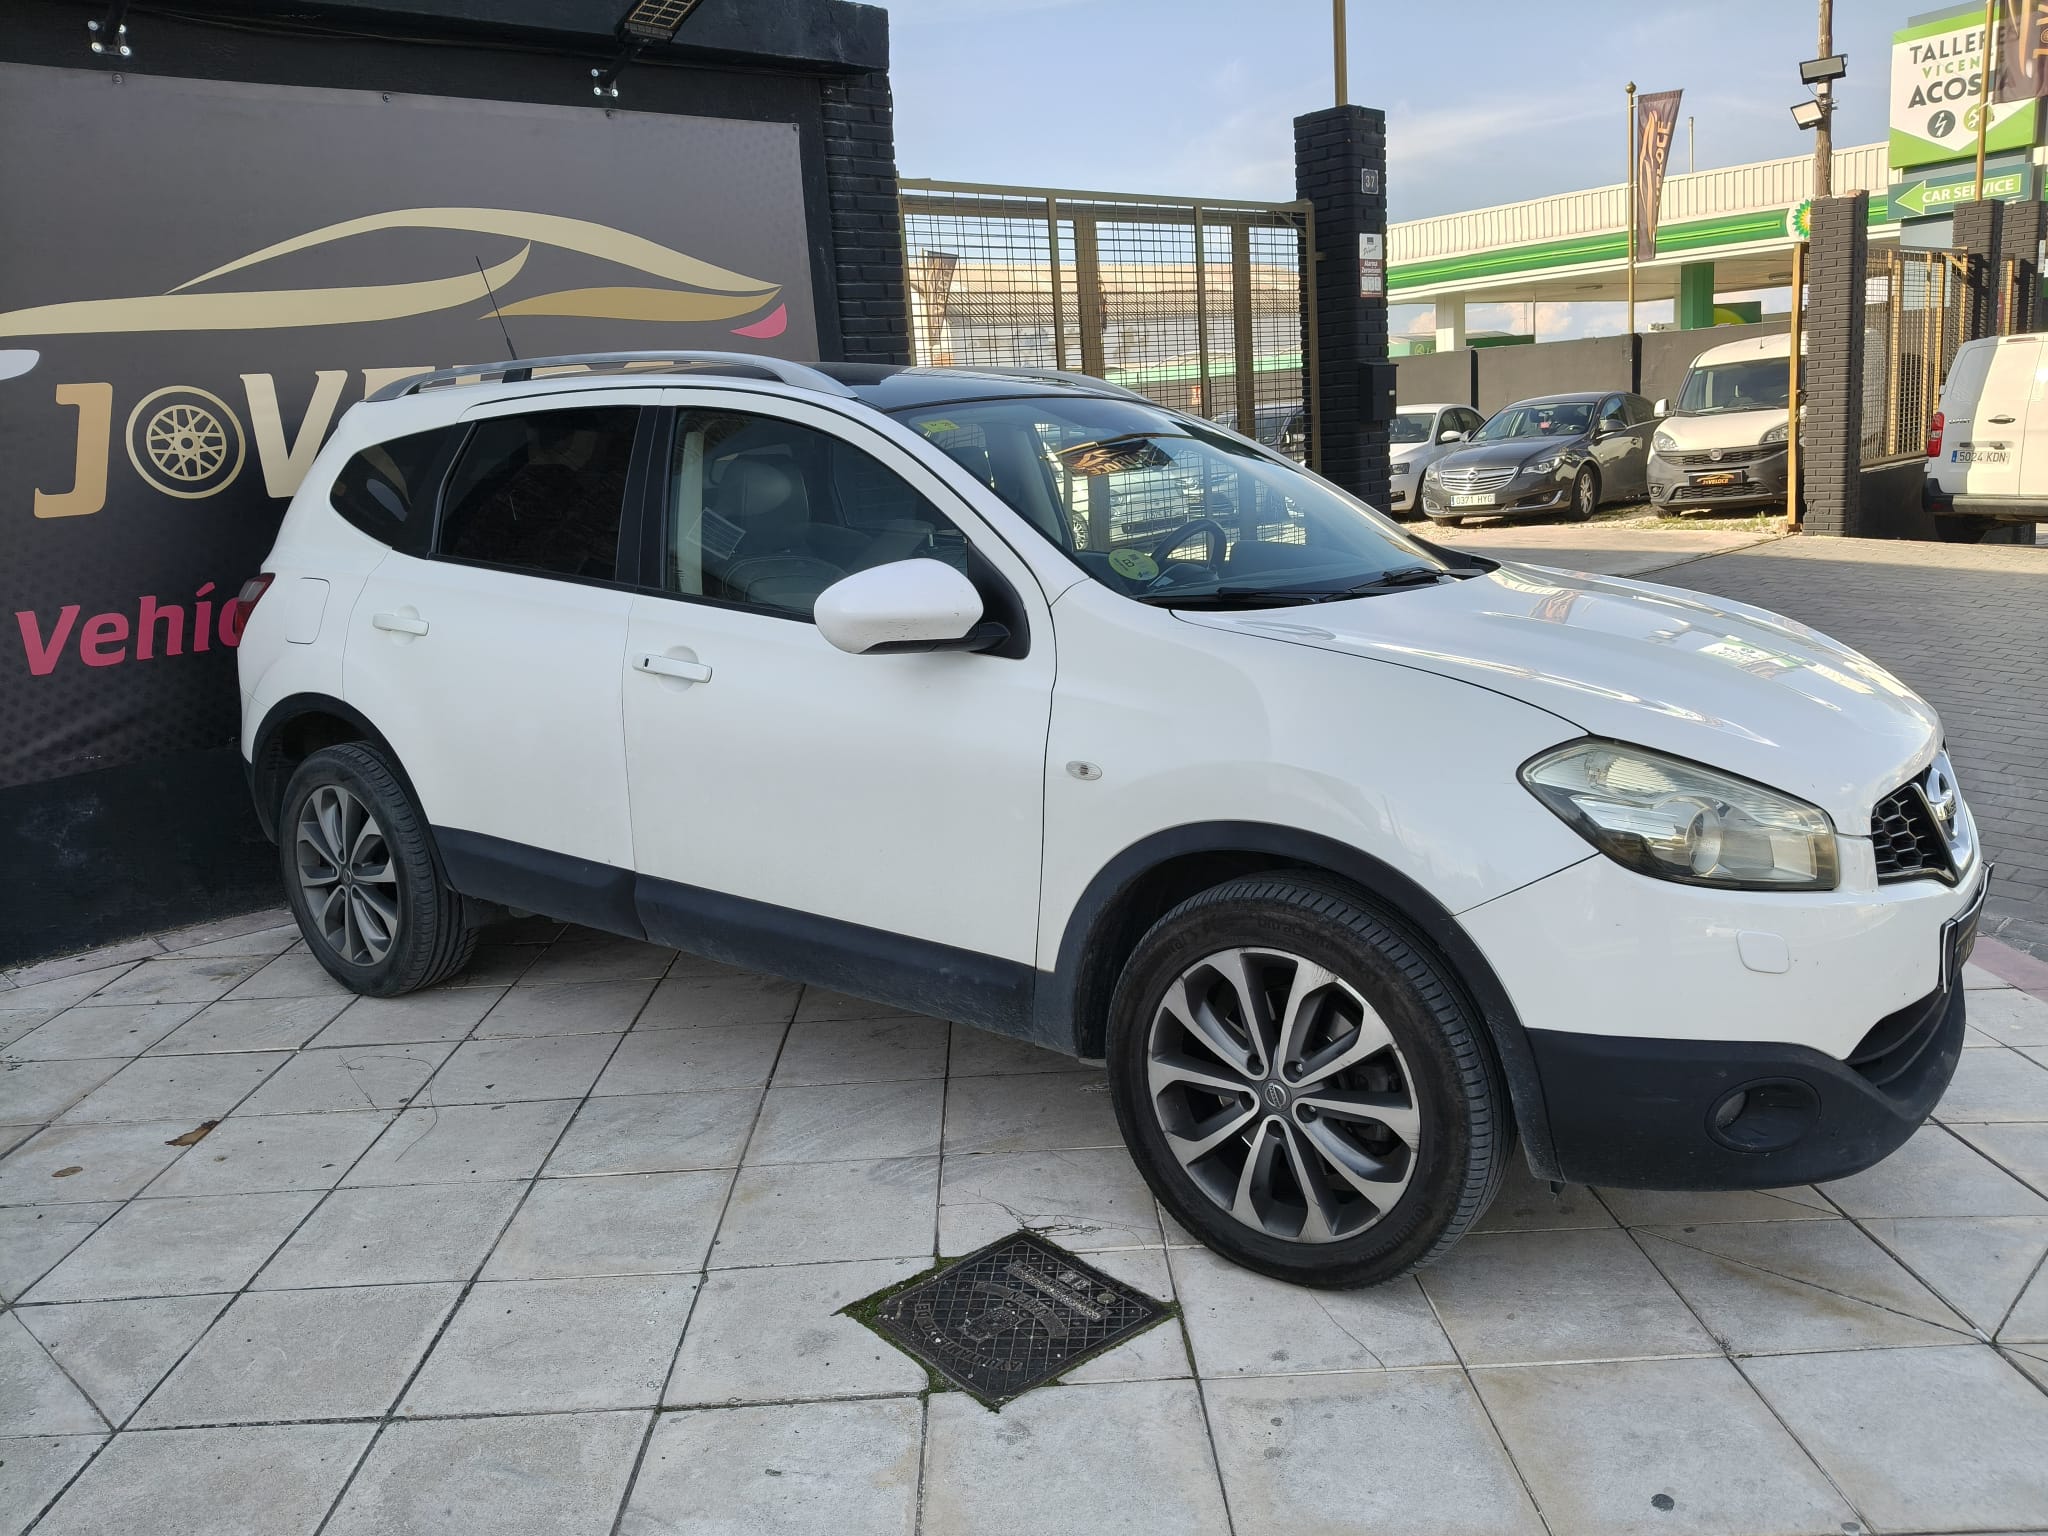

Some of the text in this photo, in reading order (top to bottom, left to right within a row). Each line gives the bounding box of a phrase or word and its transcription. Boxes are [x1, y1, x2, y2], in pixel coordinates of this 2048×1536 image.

[1922, 53, 1988, 79] VICEN
[1908, 72, 1994, 108] ACOS
[1365, 175, 1375, 188] 37
[1922, 188, 1951, 203] CAR
[1959, 451, 2007, 462] 5024 KDN
[15, 582, 241, 675] Vehíc
